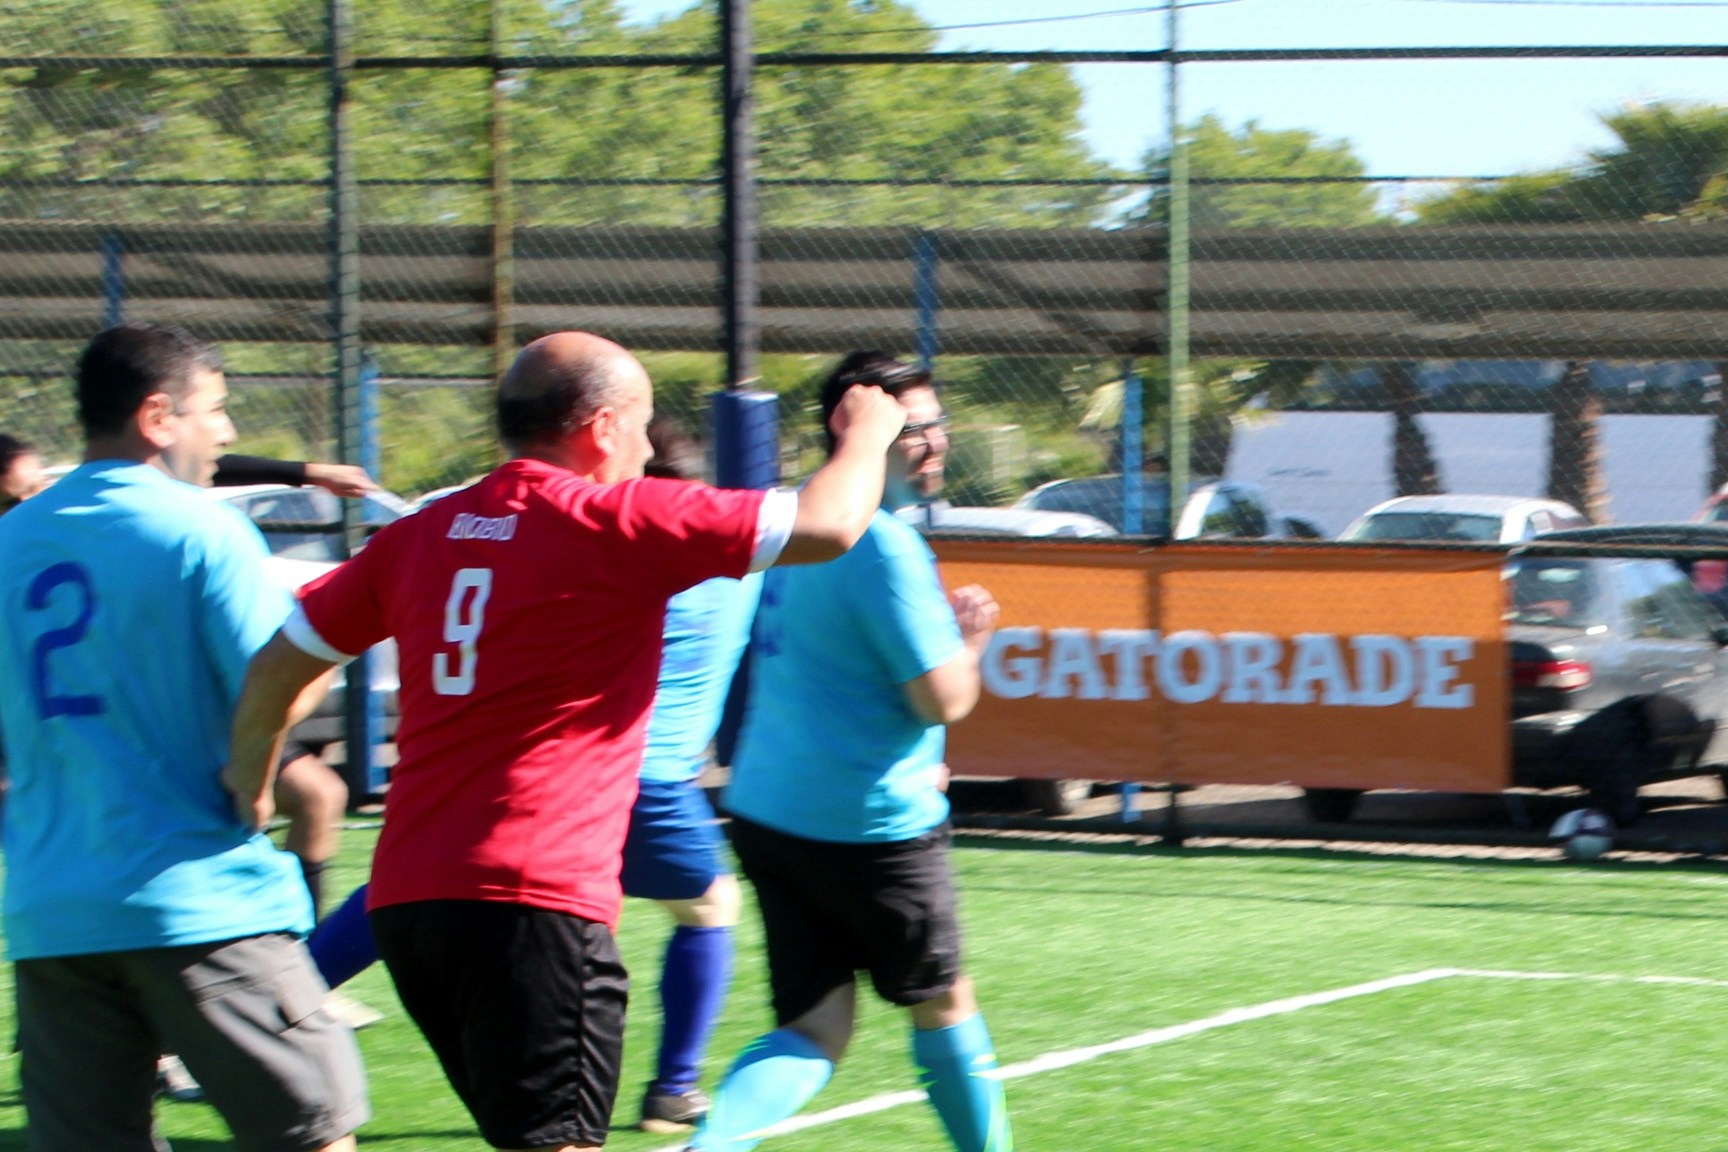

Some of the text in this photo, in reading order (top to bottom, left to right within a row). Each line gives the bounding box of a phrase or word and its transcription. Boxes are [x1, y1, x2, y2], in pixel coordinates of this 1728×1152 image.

[26, 561, 107, 720] 2
[432, 568, 493, 695] 9
[981, 626, 1475, 708] GATORADE
